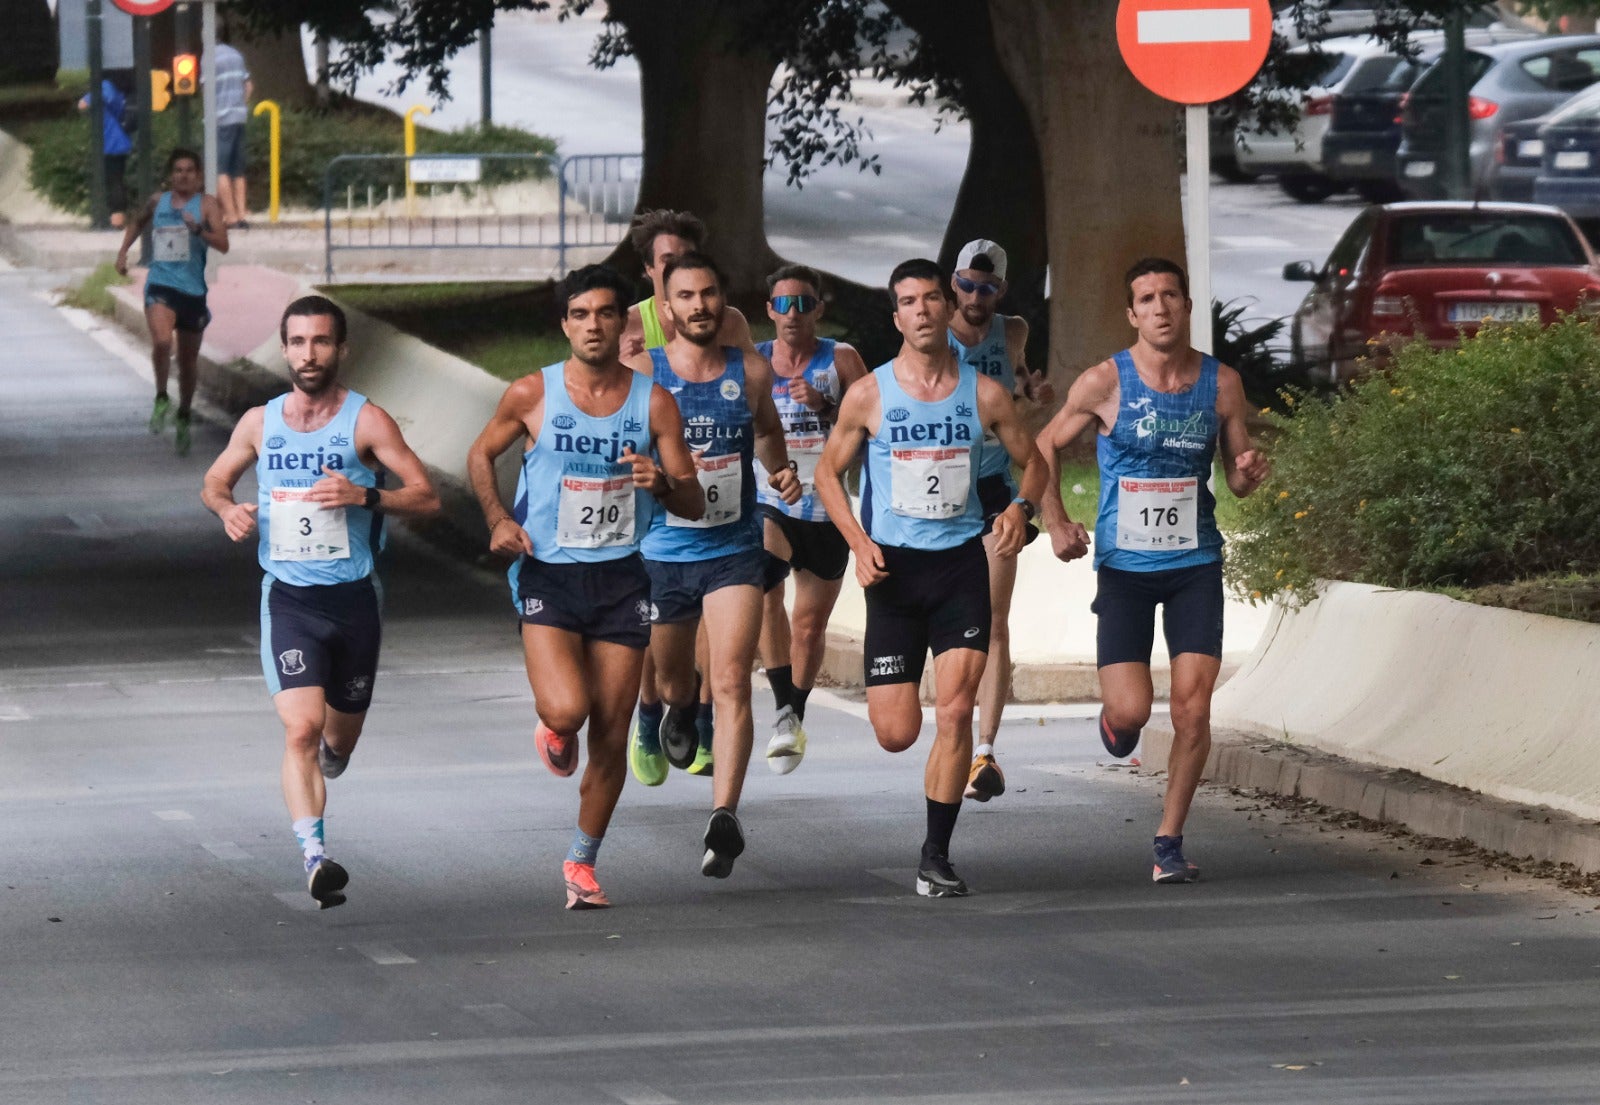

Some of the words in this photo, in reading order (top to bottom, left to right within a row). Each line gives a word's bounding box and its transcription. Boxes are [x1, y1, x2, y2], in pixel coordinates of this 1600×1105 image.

[684, 427, 743, 439] RBELLA
[889, 416, 971, 446] nerja
[553, 431, 637, 463] nerja
[1162, 438, 1206, 450] Atletismo
[267, 446, 344, 476] nerja
[706, 484, 719, 503] 6
[926, 475, 940, 495] 2
[1120, 480, 1139, 493] 42
[580, 504, 620, 525] 210
[1139, 506, 1179, 527] 176
[298, 517, 312, 536] 3
[870, 665, 905, 677] BEAST
